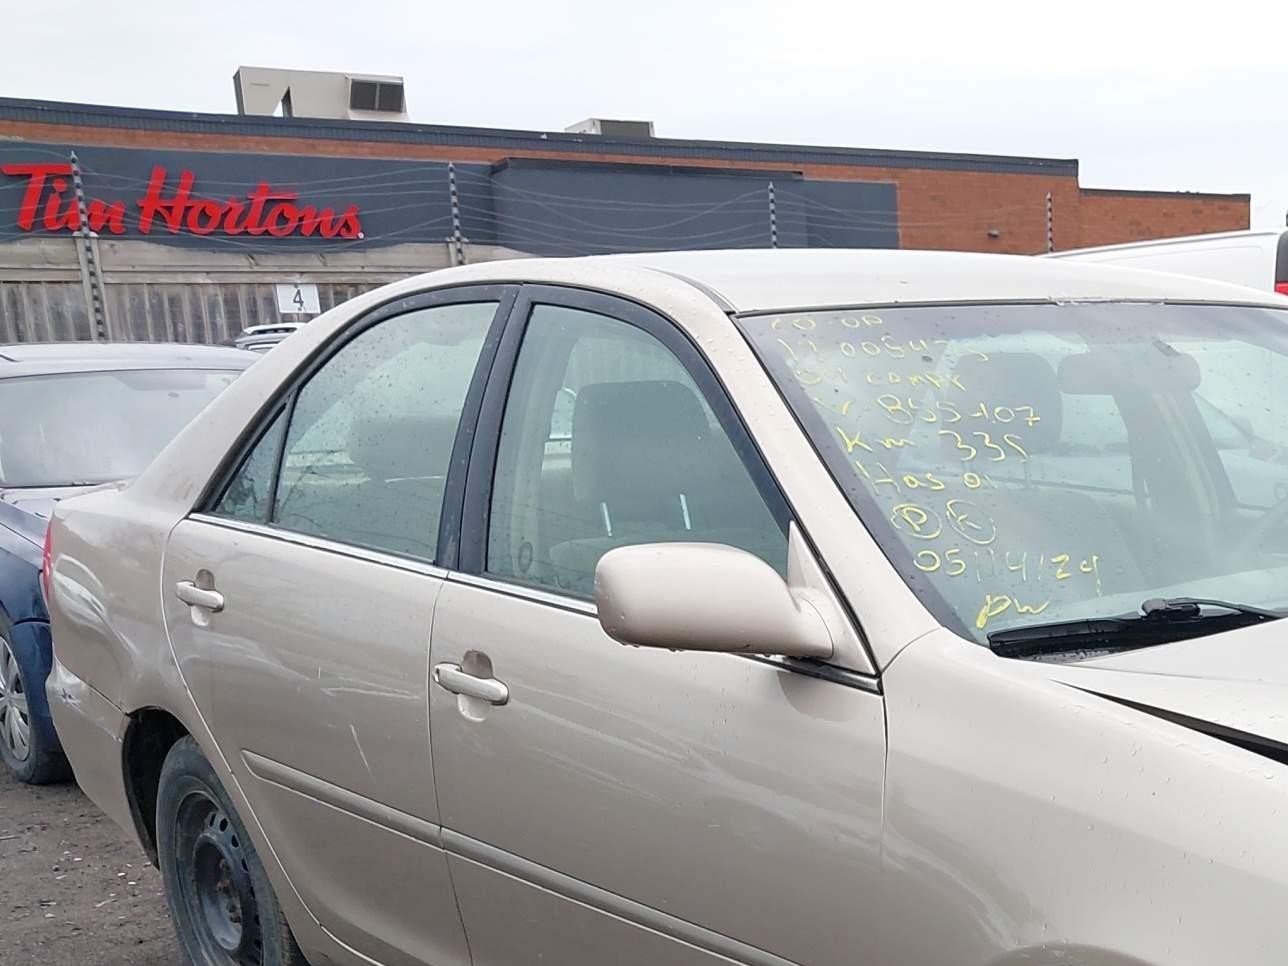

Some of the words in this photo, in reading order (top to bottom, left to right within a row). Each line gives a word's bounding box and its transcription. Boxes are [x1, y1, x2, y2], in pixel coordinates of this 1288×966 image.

[2, 163, 126, 234] Tim
[136, 165, 362, 239] Hortons
[293, 289, 304, 307] 4
[938, 429, 1031, 463] 335
